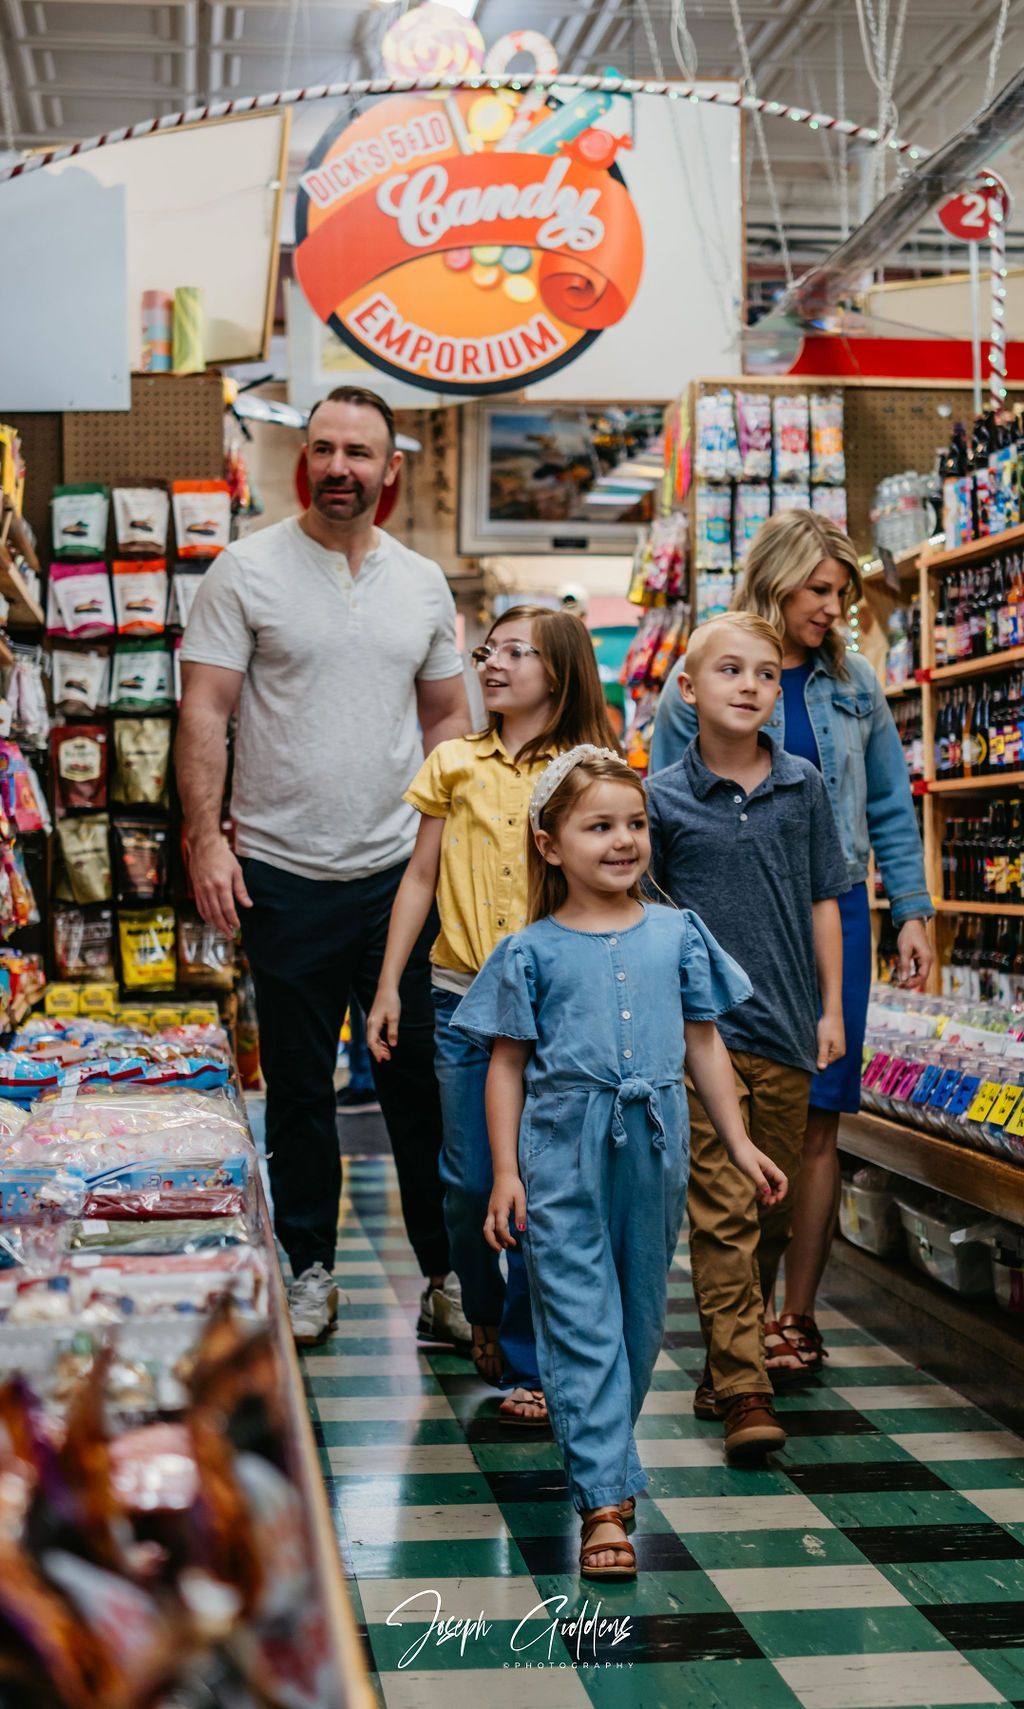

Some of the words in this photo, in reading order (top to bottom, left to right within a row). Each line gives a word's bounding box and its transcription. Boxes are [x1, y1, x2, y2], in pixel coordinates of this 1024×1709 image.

[305, 143, 385, 202] DICK'S
[376, 156, 605, 251] Candy
[354, 300, 558, 375] EMPORIUM
